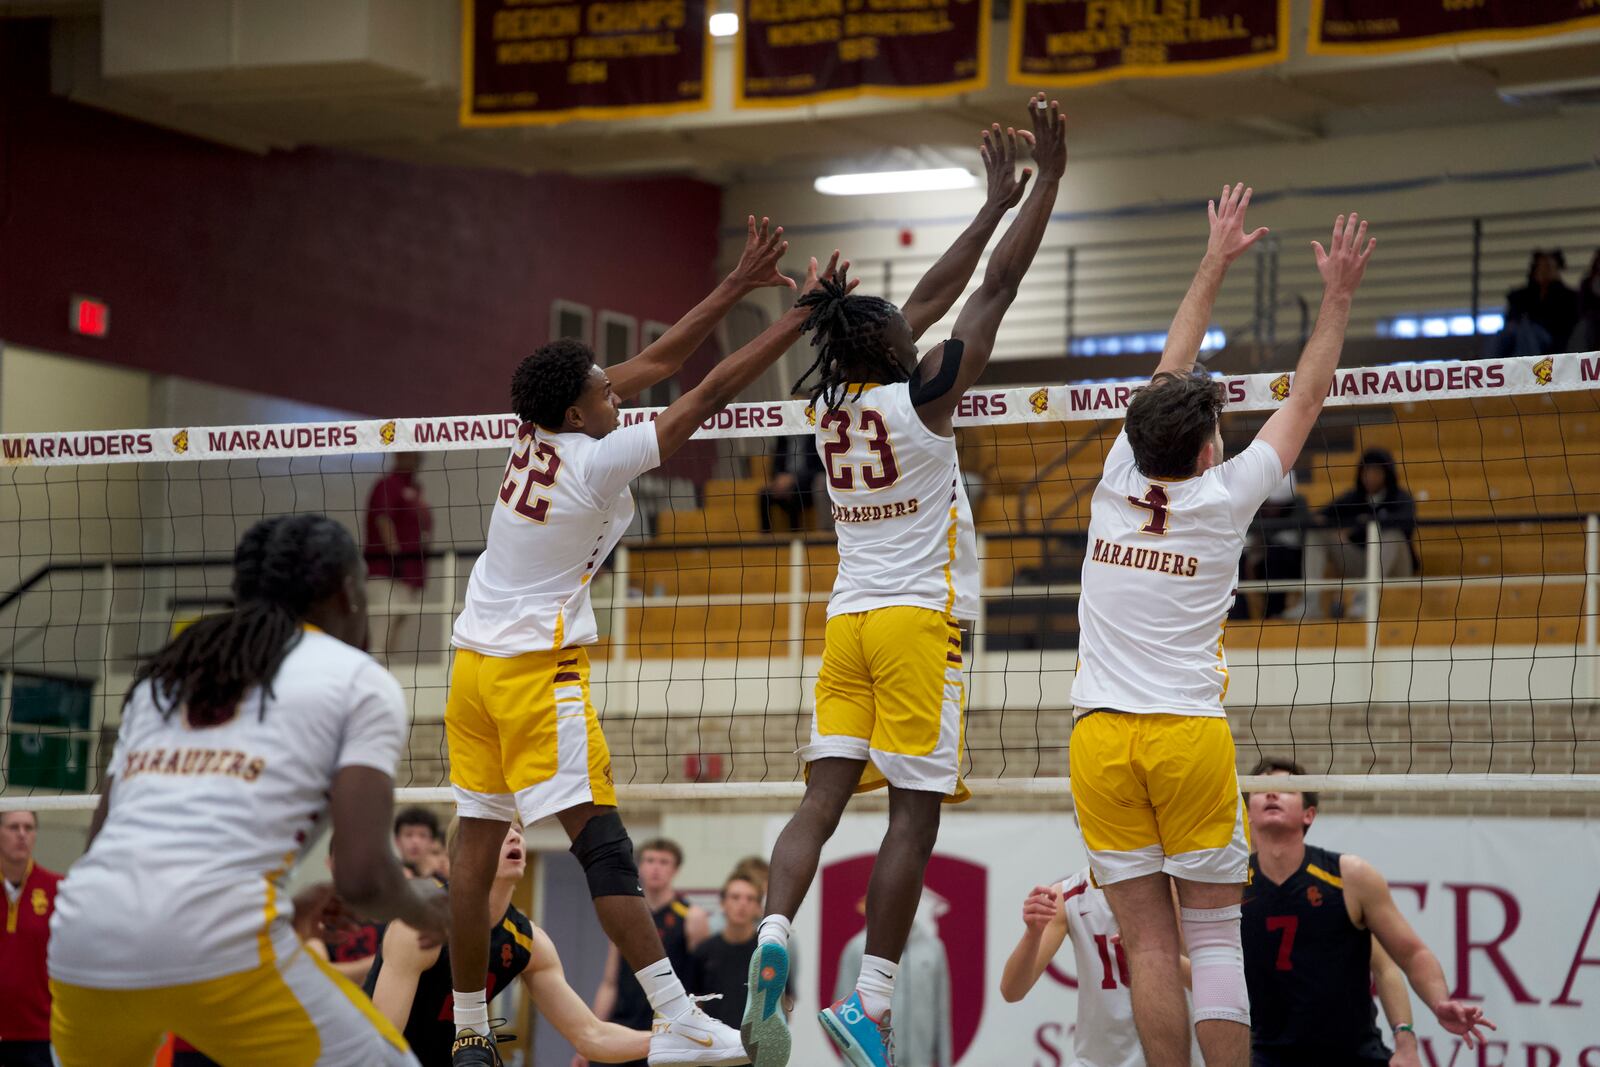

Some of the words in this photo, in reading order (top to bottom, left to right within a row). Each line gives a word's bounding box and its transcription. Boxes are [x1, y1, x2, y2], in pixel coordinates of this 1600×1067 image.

[1, 433, 153, 459] MARAUDERS
[208, 425, 358, 452] MARAUDERS
[414, 418, 517, 443] MARAUD
[820, 408, 901, 492] 23
[499, 420, 563, 524] 22
[1091, 538, 1199, 578] MARAUDERS
[1266, 915, 1298, 971] 7
